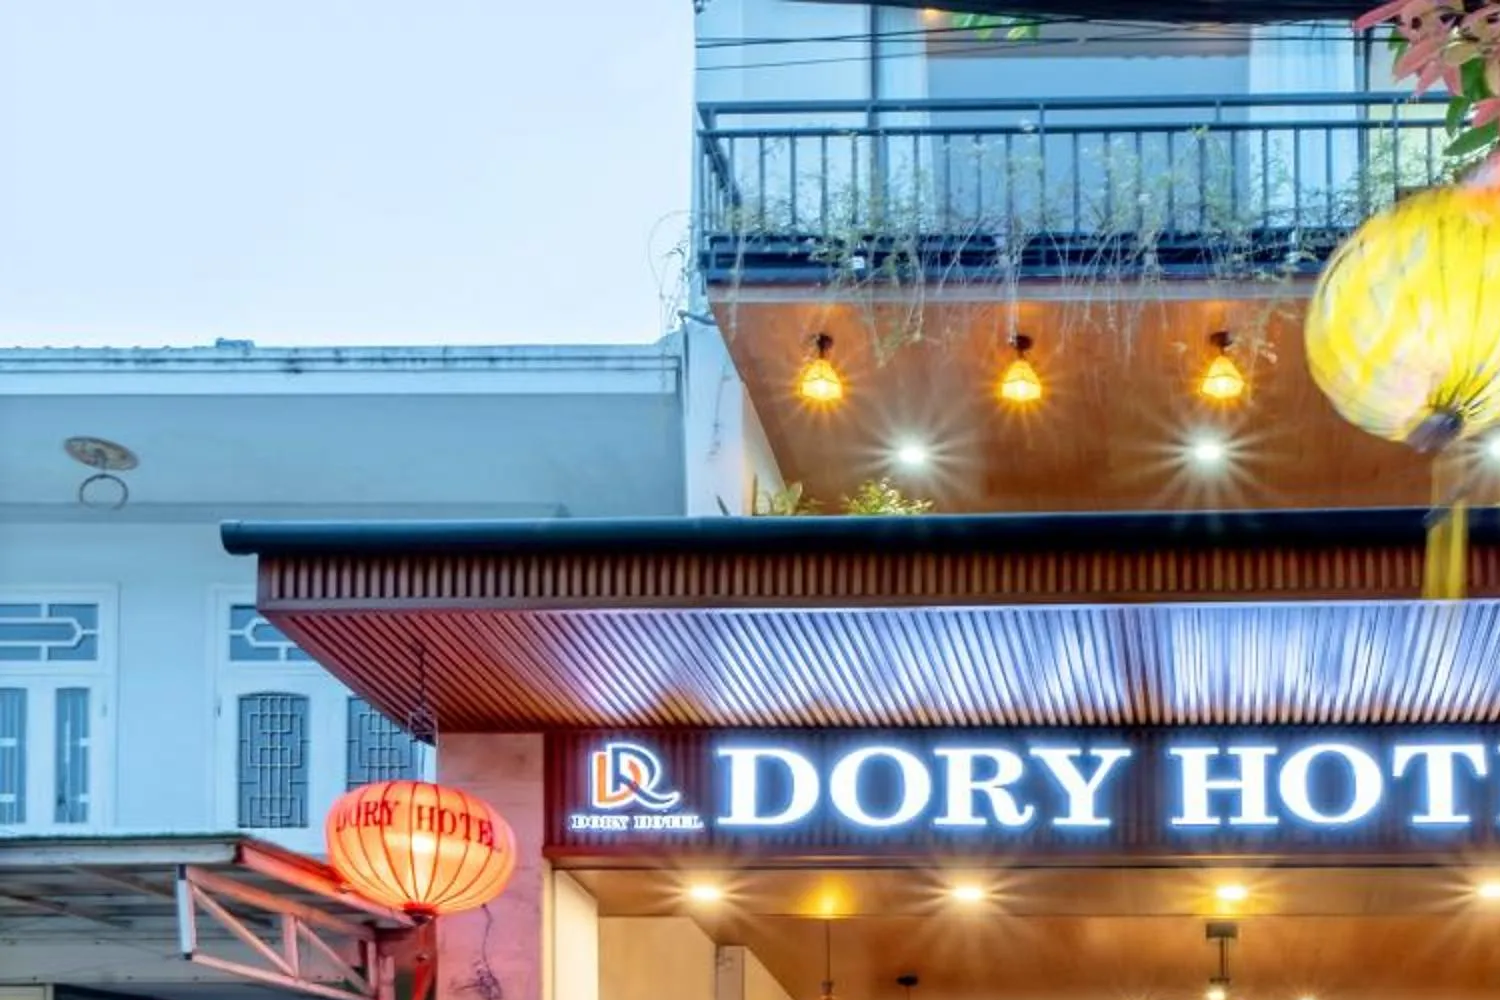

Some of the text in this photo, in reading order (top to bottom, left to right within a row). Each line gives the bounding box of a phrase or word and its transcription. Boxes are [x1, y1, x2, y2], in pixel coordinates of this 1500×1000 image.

[716, 745, 1132, 828] DORY
[570, 814, 704, 830] DORY HOTEL
